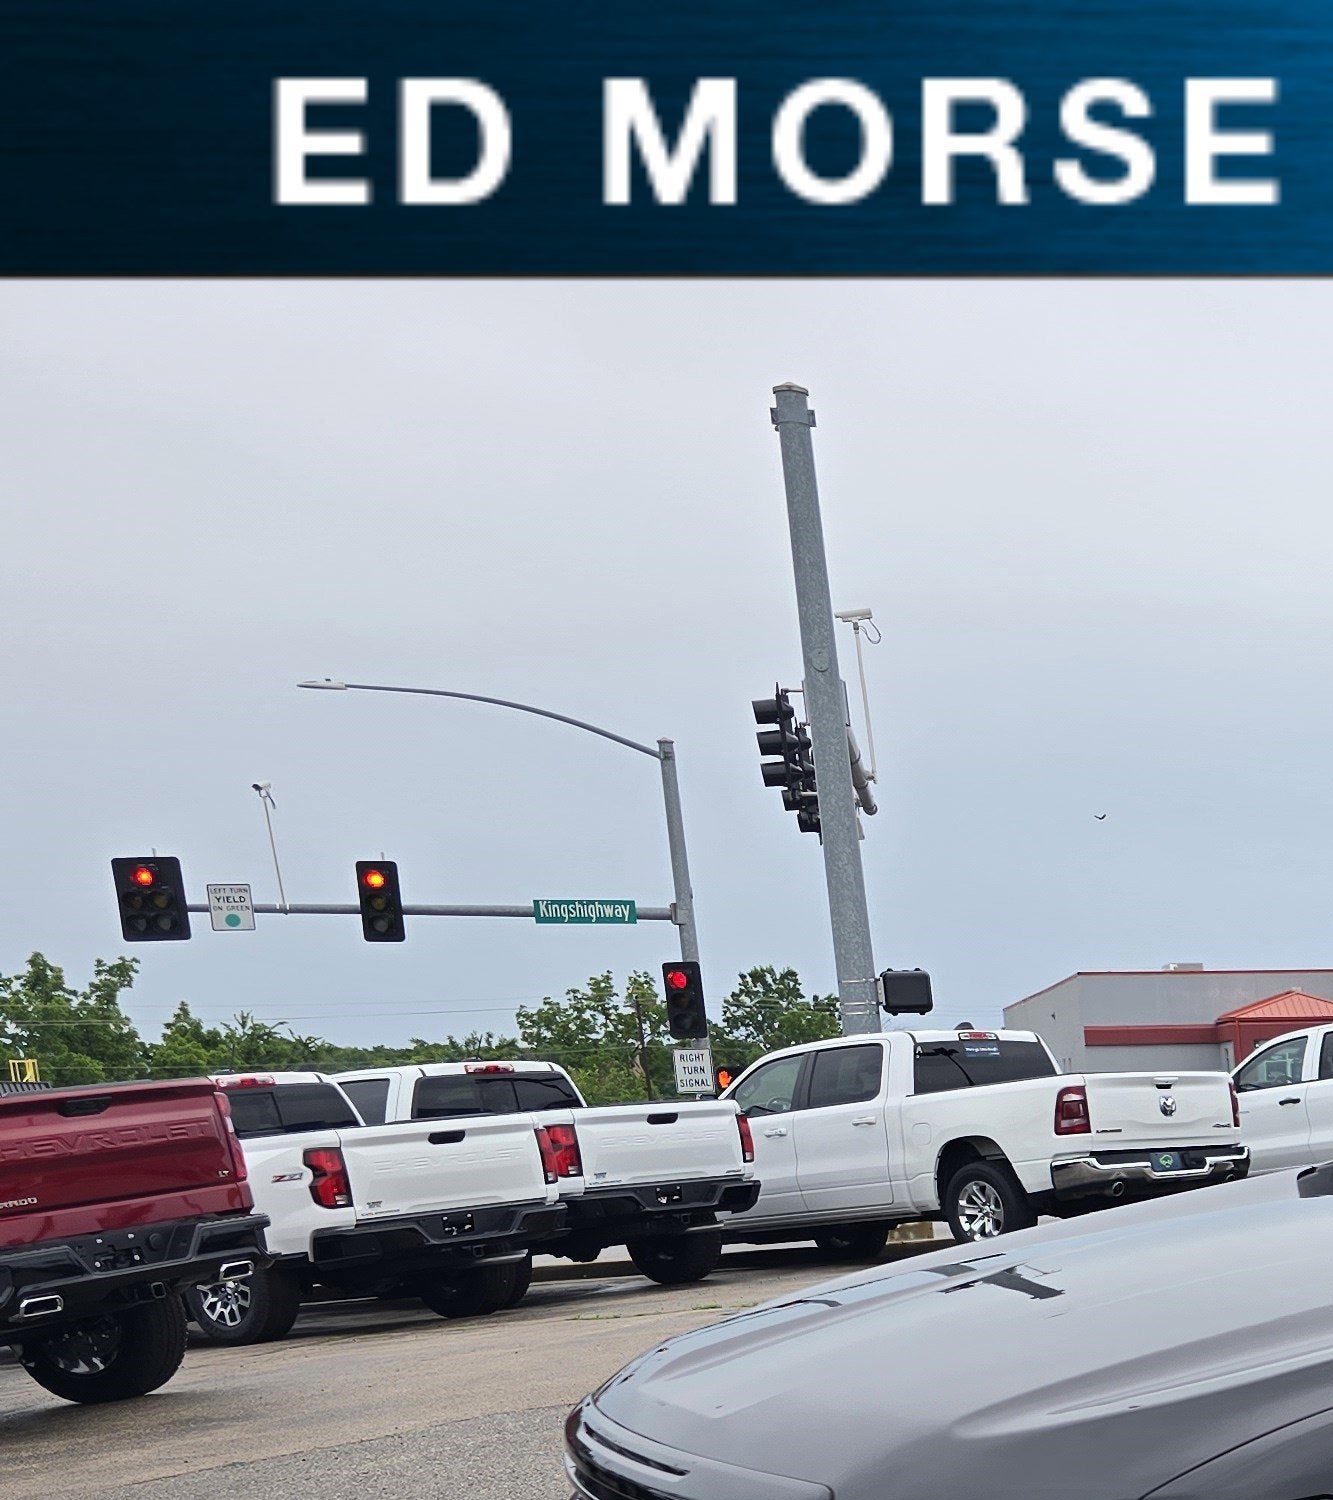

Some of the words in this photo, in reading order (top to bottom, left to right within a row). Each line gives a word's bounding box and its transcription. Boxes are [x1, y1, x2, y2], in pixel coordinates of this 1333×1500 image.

[214, 895, 246, 903] YIELD
[539, 900, 630, 922] Kingshighway
[679, 1053, 704, 1062] RIGHT
[682, 1066, 705, 1075] TURN
[680, 1079, 711, 1088] SIGNAL
[0, 1119, 210, 1162] HEVROLET
